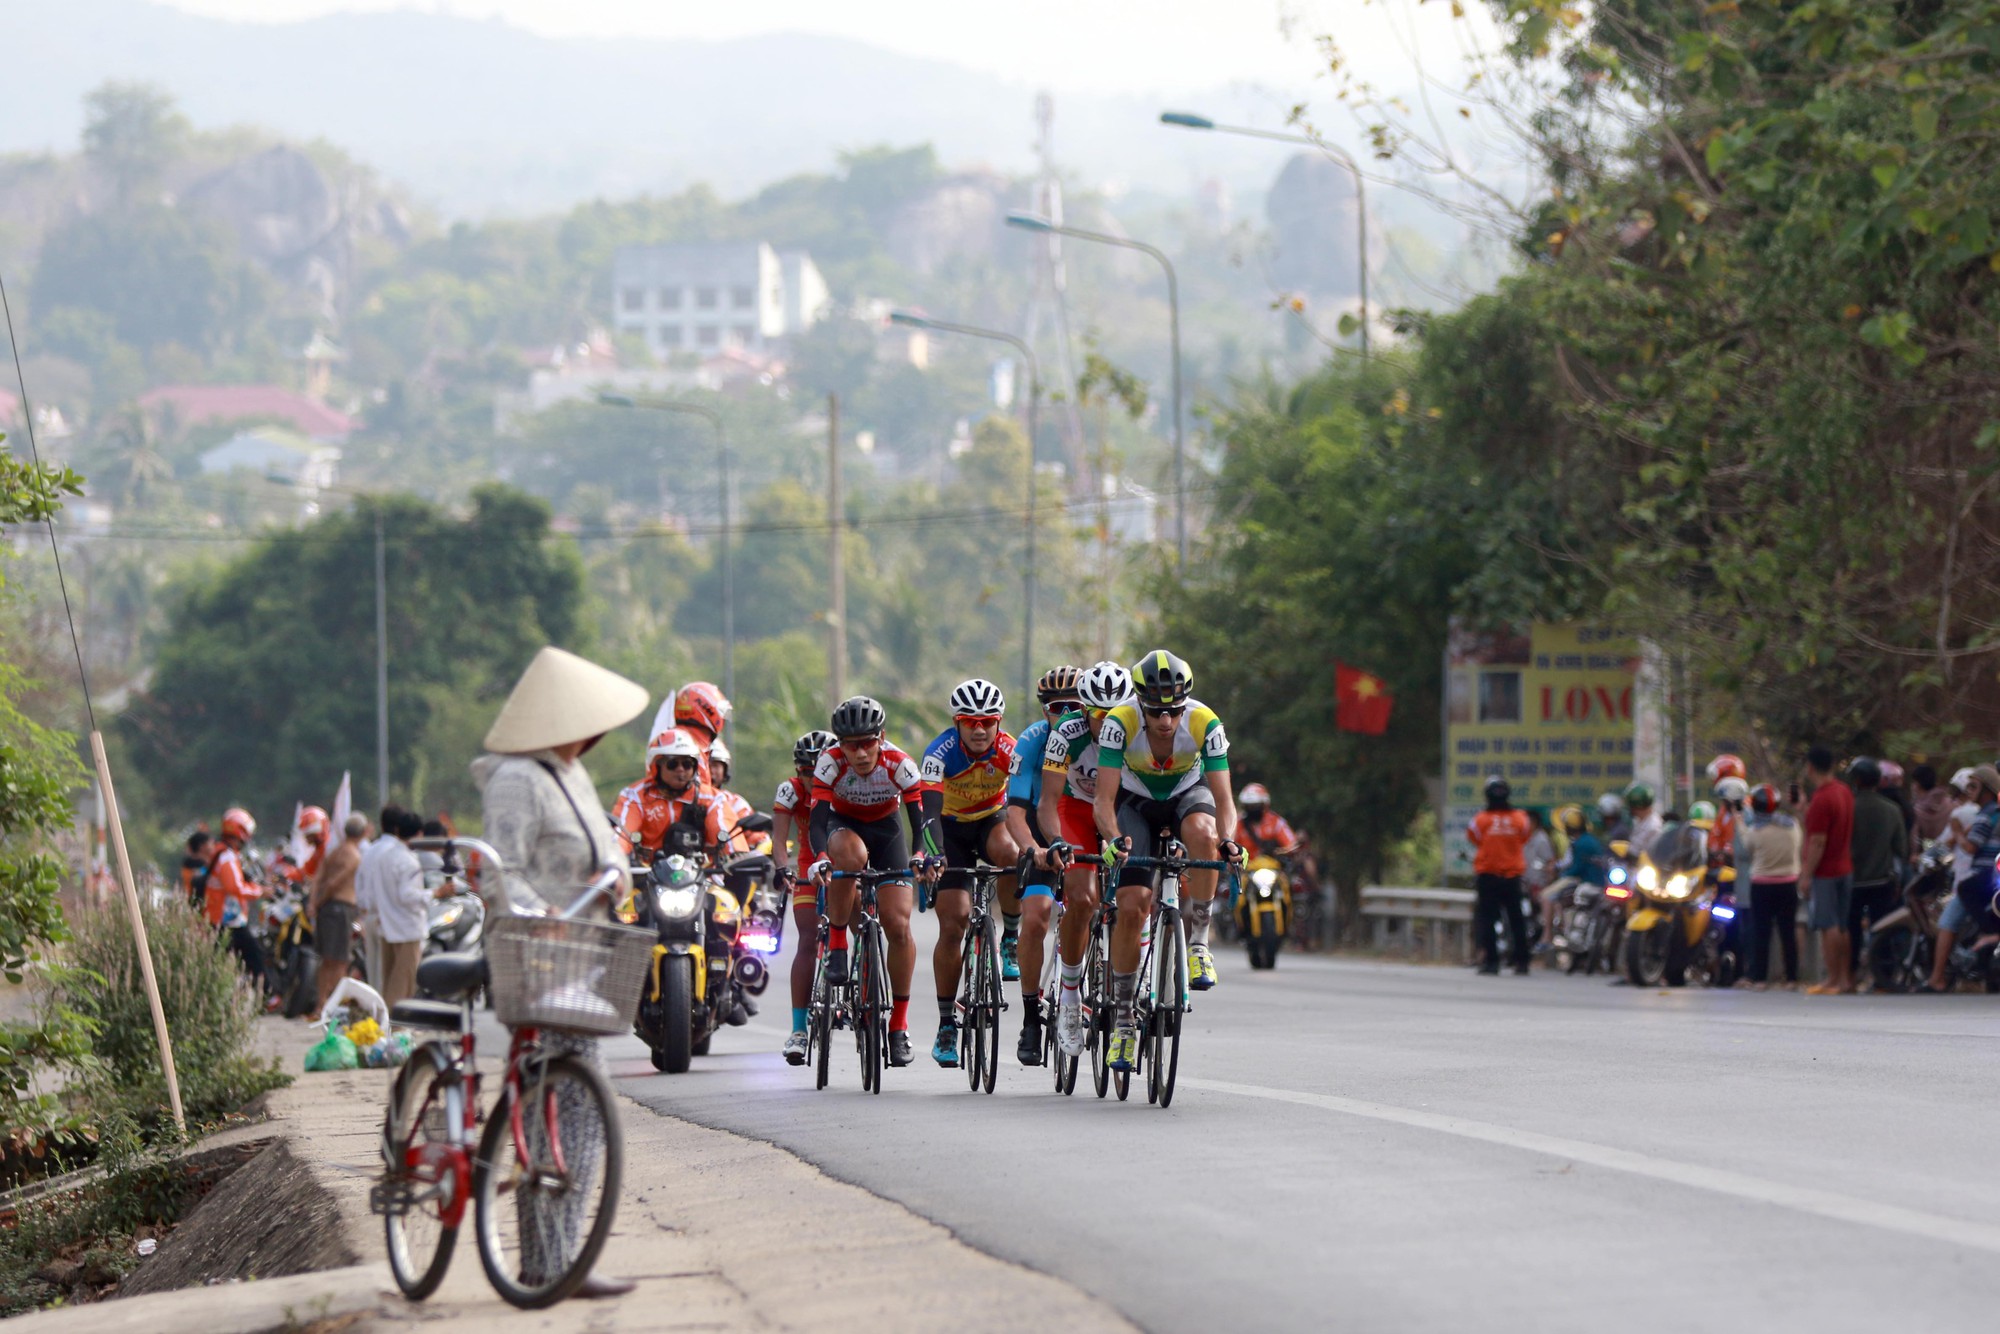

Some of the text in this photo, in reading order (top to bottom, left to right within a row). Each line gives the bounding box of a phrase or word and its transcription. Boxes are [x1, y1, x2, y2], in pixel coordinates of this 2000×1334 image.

[1100, 724, 1123, 743] 116
[821, 763, 832, 776] 4
[903, 767, 914, 779] 4
[925, 761, 940, 776] 64
[779, 786, 794, 802] 84
